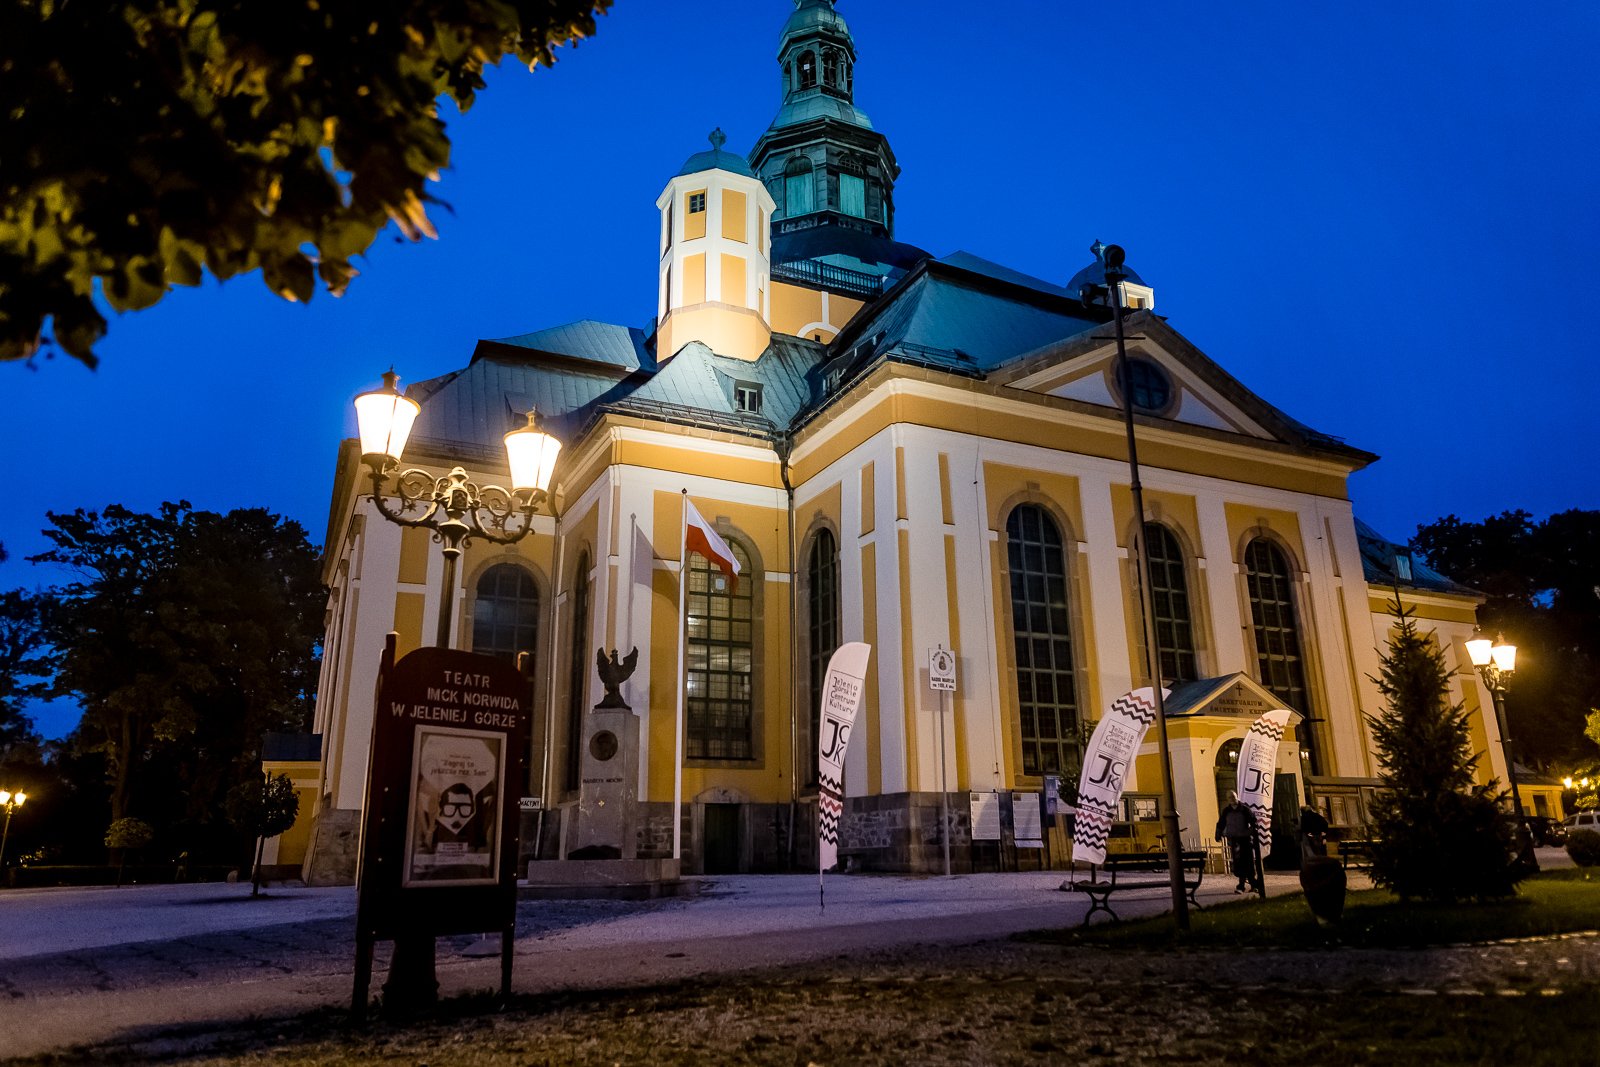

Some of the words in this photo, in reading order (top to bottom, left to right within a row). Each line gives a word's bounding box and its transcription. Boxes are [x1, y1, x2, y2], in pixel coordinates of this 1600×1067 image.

[444, 670, 491, 688] TEATR
[464, 691, 519, 711] NORWIDA
[829, 699, 854, 715] Kultury
[830, 690, 856, 706] Centrum
[391, 701, 406, 717] W
[410, 704, 467, 723] JELENIEJ
[474, 709, 516, 728] GÓRZE
